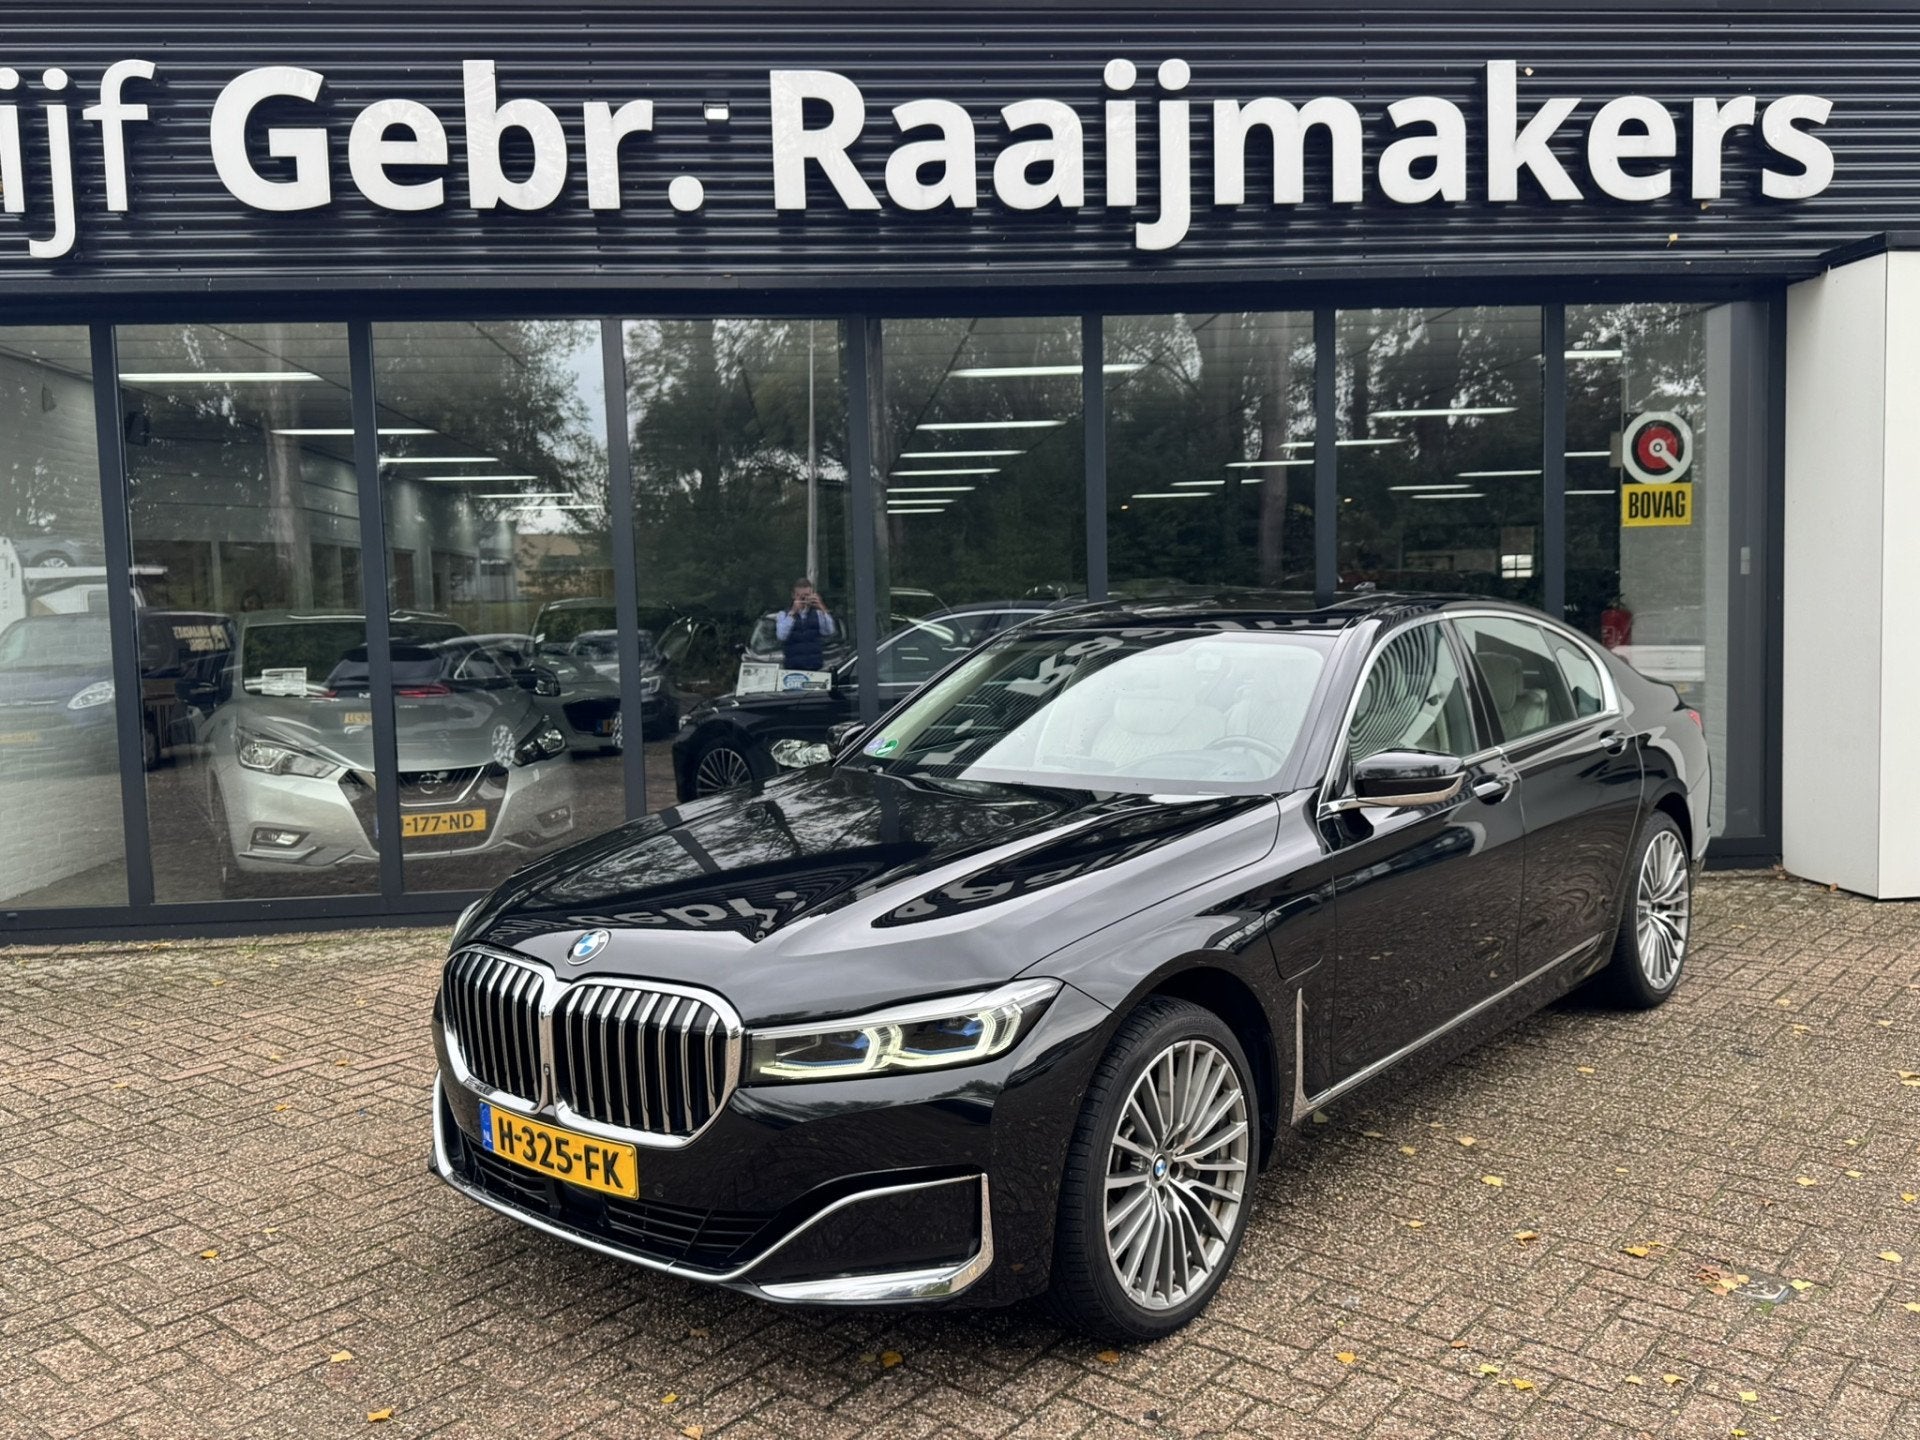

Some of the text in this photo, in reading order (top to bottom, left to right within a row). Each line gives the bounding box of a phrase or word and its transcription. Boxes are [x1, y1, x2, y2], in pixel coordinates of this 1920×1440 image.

[210, 60, 704, 212] Gebr.
[769, 58, 1835, 250] Raaijmakers
[1628, 490, 1686, 519] BOVAG
[498, 1116, 624, 1189] H-325-FK
